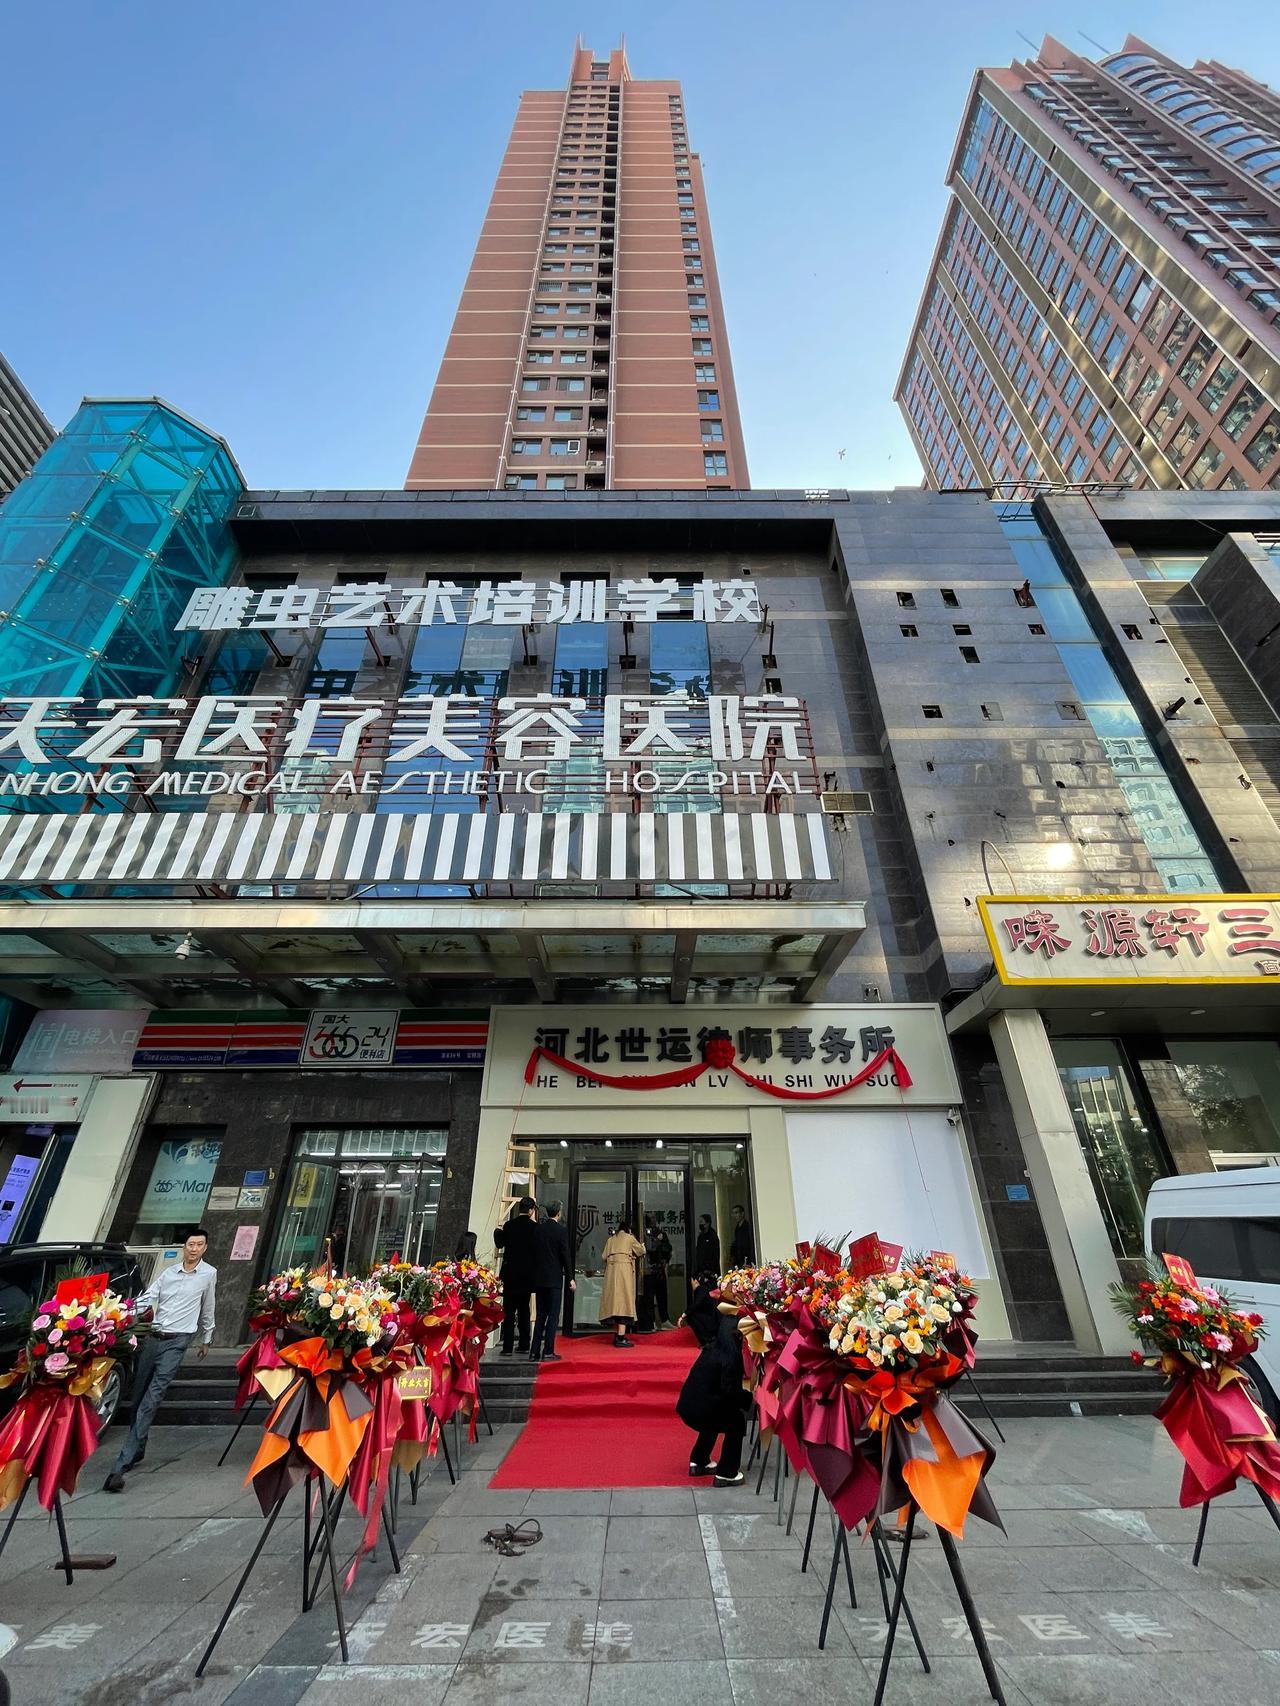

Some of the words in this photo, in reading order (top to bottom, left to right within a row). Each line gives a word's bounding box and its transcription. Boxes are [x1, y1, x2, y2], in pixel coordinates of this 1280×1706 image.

[175, 579, 762, 631] 雕虫艺术培训学校
[0, 694, 807, 763] 天宏医疗美容医院
[144, 771, 309, 796] MEDICAL
[604, 770, 813, 795] HOSPITAL
[322, 1014, 350, 1024] 国大
[361, 1026, 390, 1047] 24
[537, 1075, 558, 1088] HE
[709, 1075, 729, 1088] LV
[785, 1075, 813, 1088] SHI
